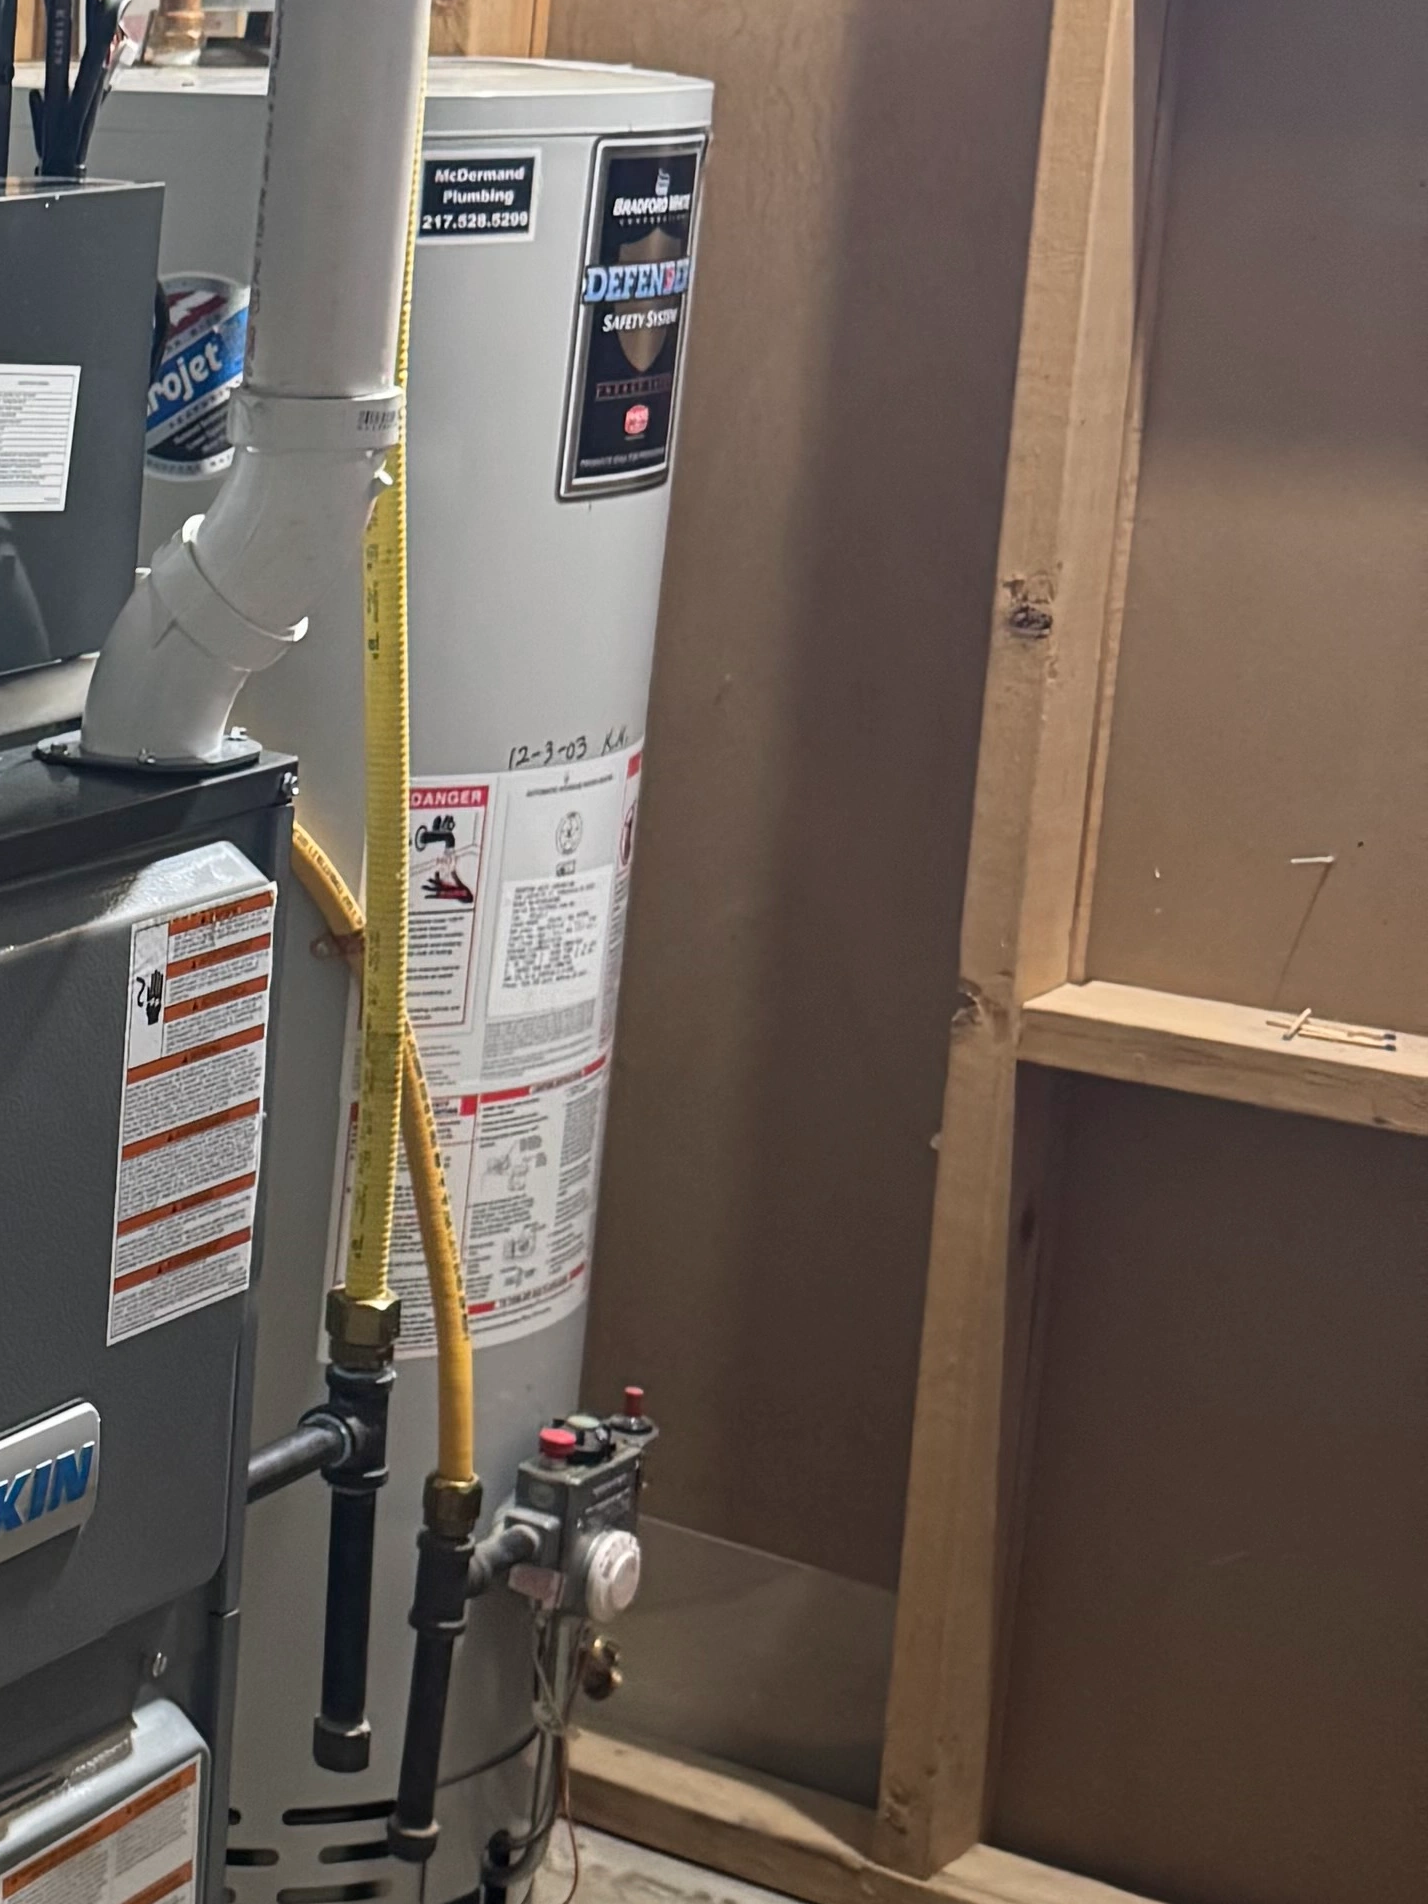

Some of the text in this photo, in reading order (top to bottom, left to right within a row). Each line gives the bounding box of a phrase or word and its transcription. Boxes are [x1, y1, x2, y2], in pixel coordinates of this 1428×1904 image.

[434, 166, 525, 183] McDermand
[443, 187, 515, 206] Plumbing
[613, 195, 669, 216] BRADFORD
[602, 311, 644, 333] SAFETY
[146, 340, 223, 416] rojet
[508, 735, 587, 771] 12-3-03
[411, 789, 482, 806] DANGER
